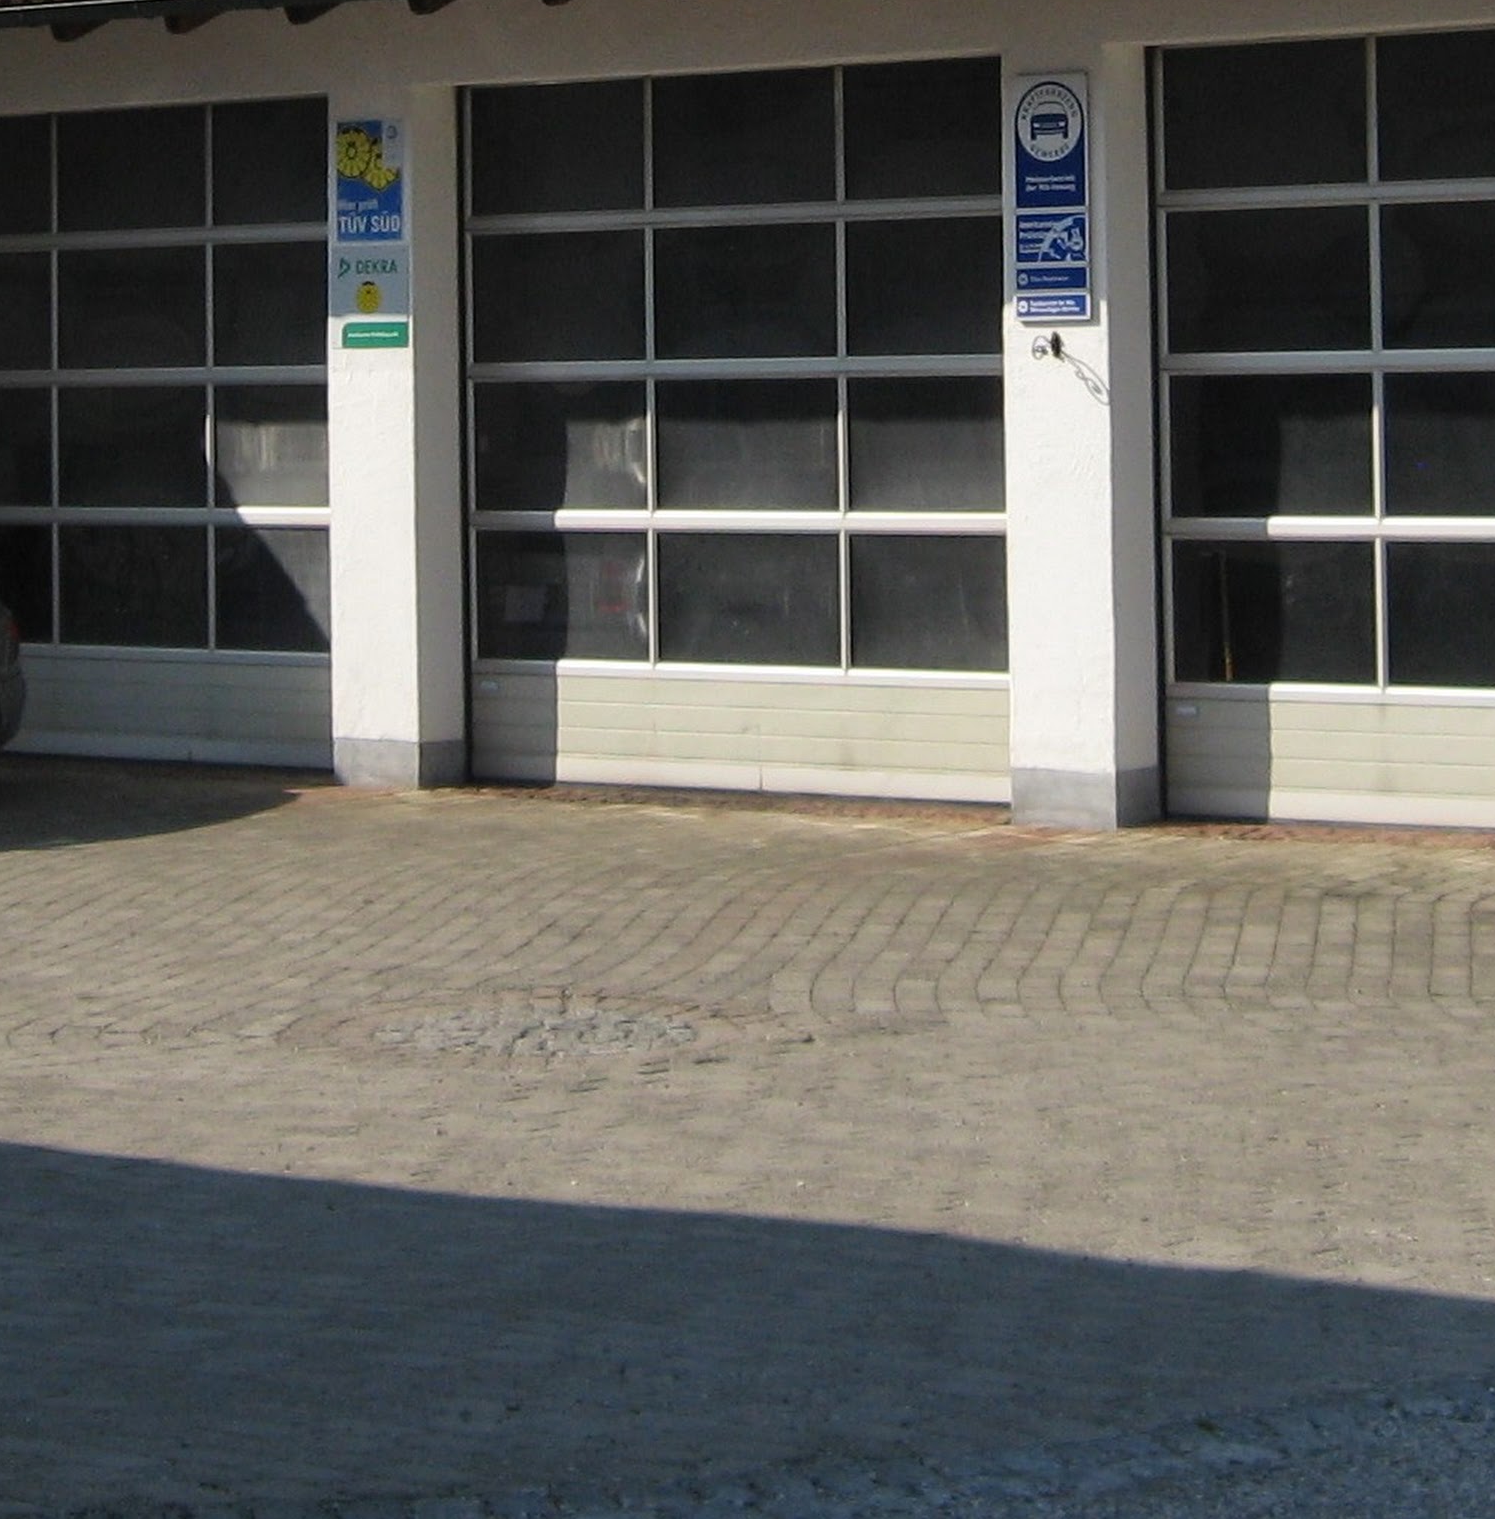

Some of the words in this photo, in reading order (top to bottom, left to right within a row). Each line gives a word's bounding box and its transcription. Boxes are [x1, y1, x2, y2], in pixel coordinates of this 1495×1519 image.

[339, 211, 367, 233] TÜV
[370, 211, 401, 232] SÜD
[356, 259, 398, 275] DEKRA
